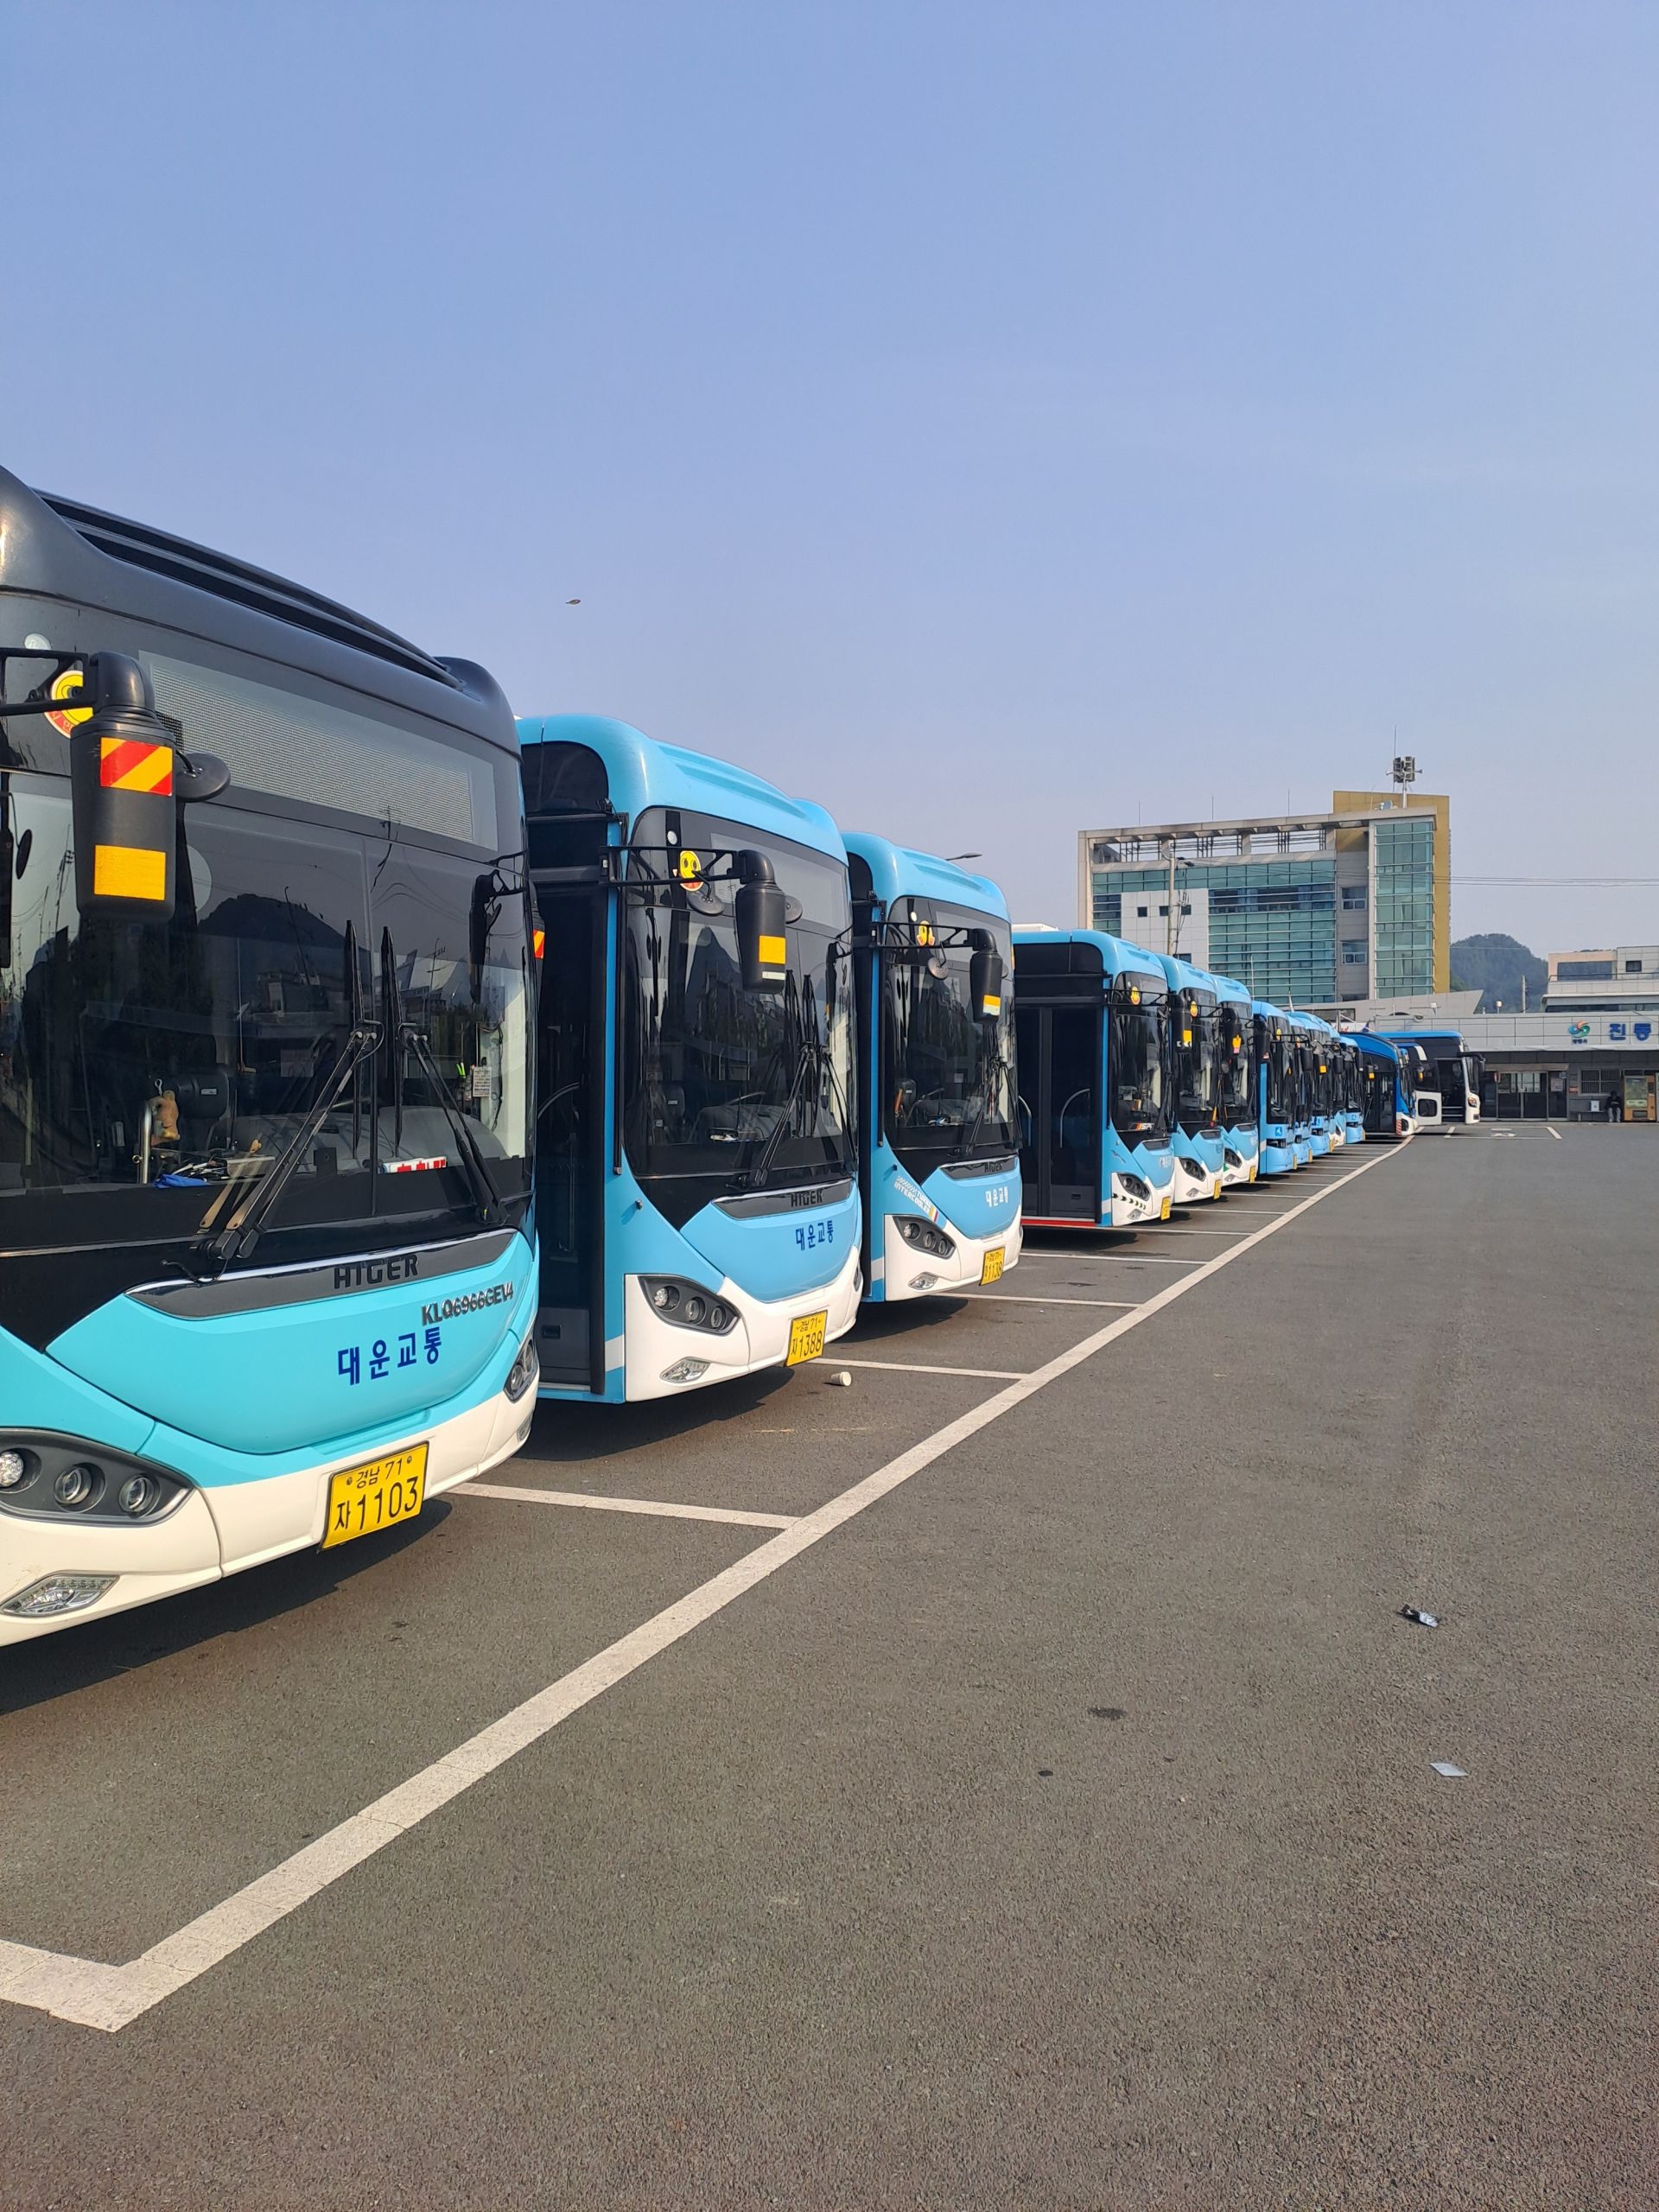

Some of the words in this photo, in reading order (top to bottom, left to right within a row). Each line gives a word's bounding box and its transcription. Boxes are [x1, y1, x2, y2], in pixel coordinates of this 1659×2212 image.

[791, 1188, 823, 1207] HIGER
[795, 1220, 835, 1252] 대운교통
[334, 1255, 419, 1289] HIGER
[810, 1316, 818, 1330] 71
[337, 1326, 442, 1386] 대운교통
[356, 1465, 381, 1489] 경남
[385, 1457, 403, 1480] 71
[334, 1475, 419, 1531] 자1103
